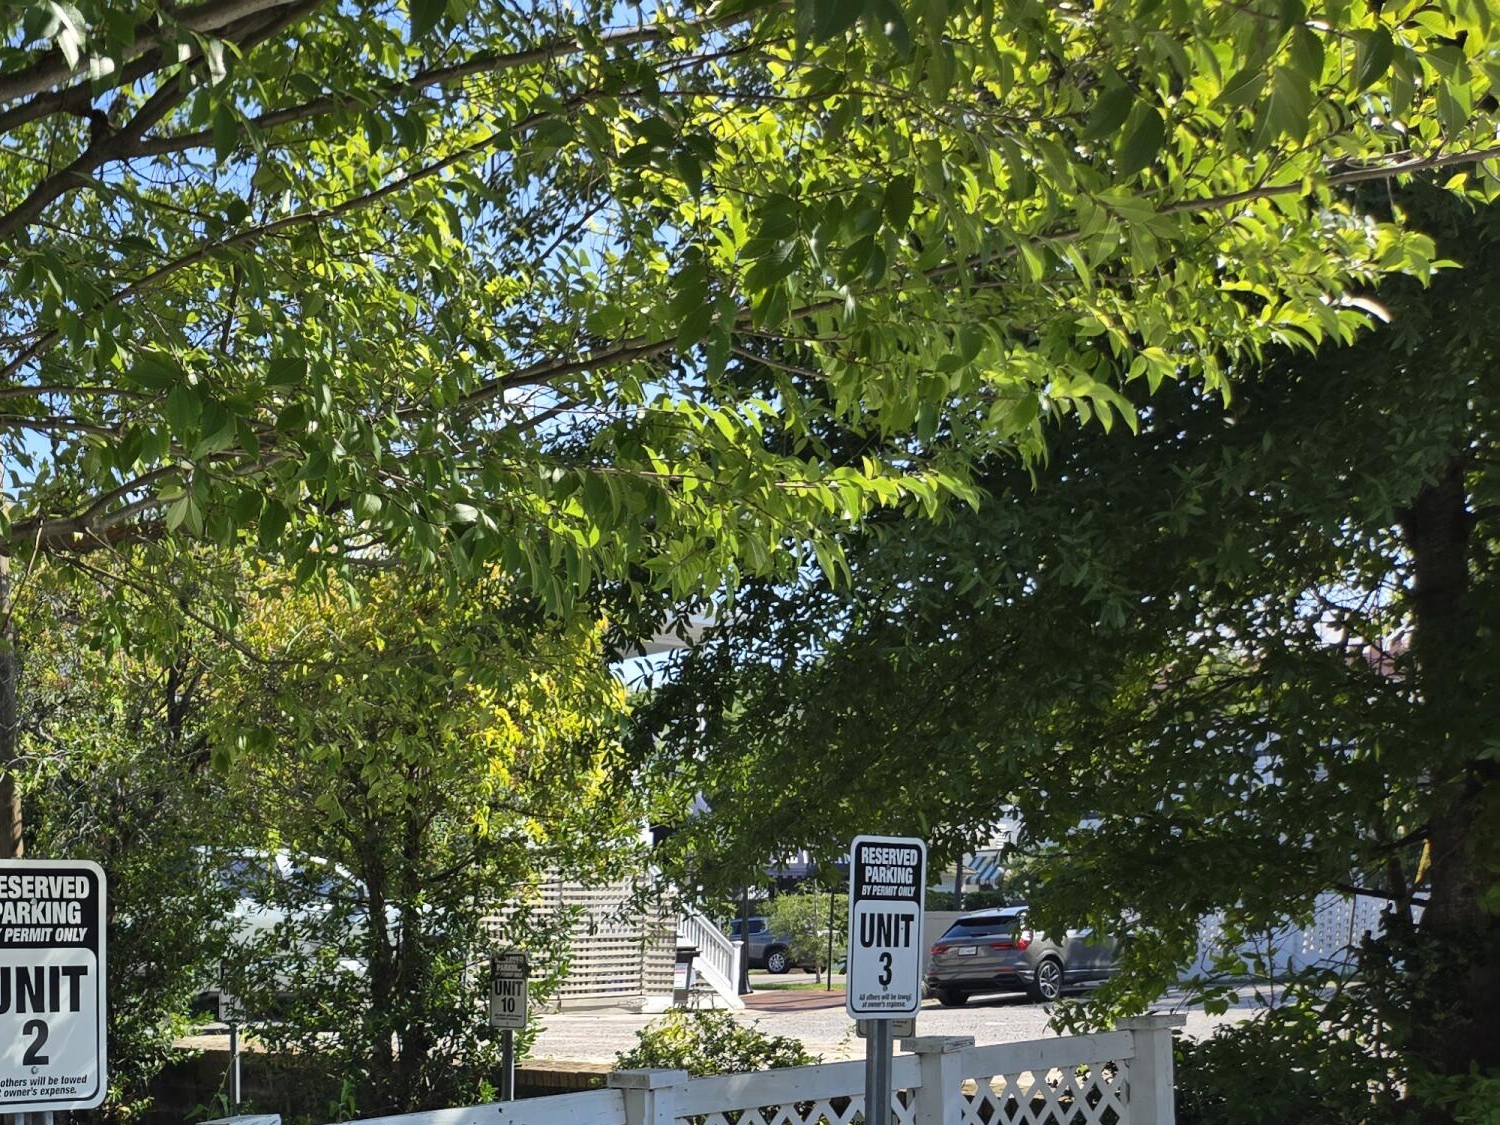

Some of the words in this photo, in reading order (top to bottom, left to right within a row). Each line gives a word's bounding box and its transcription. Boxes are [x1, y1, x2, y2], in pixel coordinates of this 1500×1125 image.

[861, 847, 918, 866] RESERVED
[865, 866, 913, 885] PARKING
[861, 885, 871, 896] BY
[872, 885, 898, 896] PERMIT
[898, 886, 916, 897] ONLY
[4, 928, 53, 942] PERMIT
[55, 928, 88, 942] ONLY
[860, 912, 914, 948] UNIT
[878, 951, 893, 987] 3
[494, 981, 523, 997] UNIT
[501, 997, 515, 1013] 10
[22, 1019, 49, 1066] 2
[0, 1078, 27, 1088] others
[30, 1076, 46, 1086] will
[48, 1075, 58, 1085] be
[61, 1074, 87, 1085] towed
[4, 1087, 37, 1097] owner's
[40, 1086, 77, 1096] expense.
